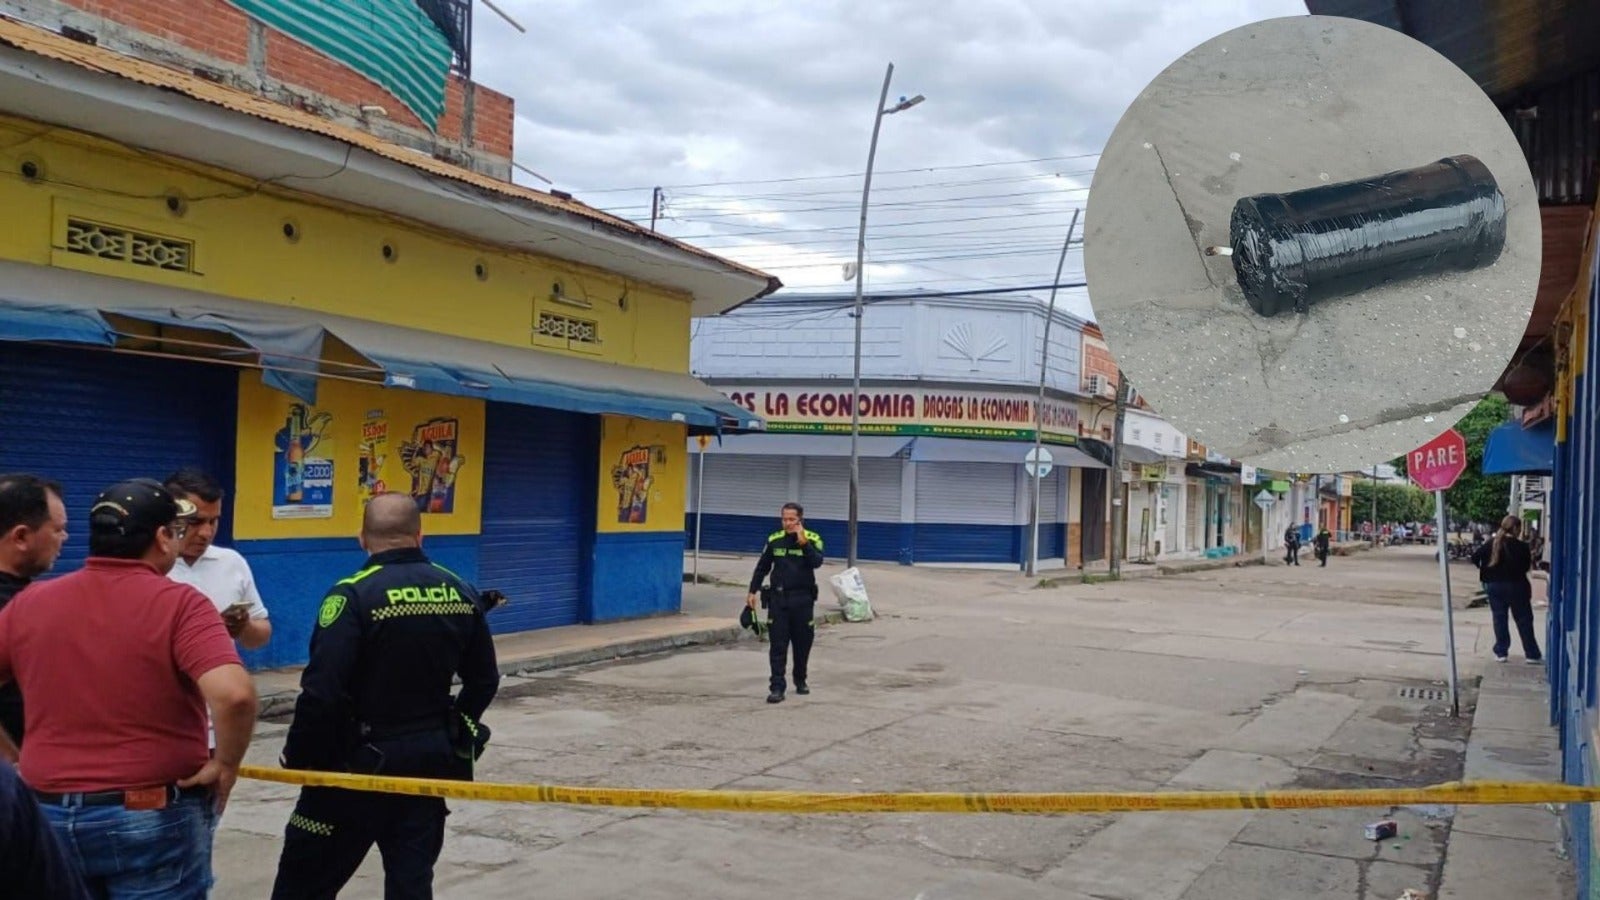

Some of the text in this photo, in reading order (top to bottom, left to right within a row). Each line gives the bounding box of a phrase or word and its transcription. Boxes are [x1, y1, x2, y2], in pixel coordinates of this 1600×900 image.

[765, 392, 788, 416] LA
[796, 393, 915, 417] ECONOMIA
[923, 395, 963, 419] DROGAS
[967, 396, 978, 420] LA
[981, 397, 1029, 422] ECONOMIA
[933, 426, 1017, 436] DROGUERIA
[1414, 444, 1458, 472] PARE
[387, 583, 463, 604] POLICÍA
